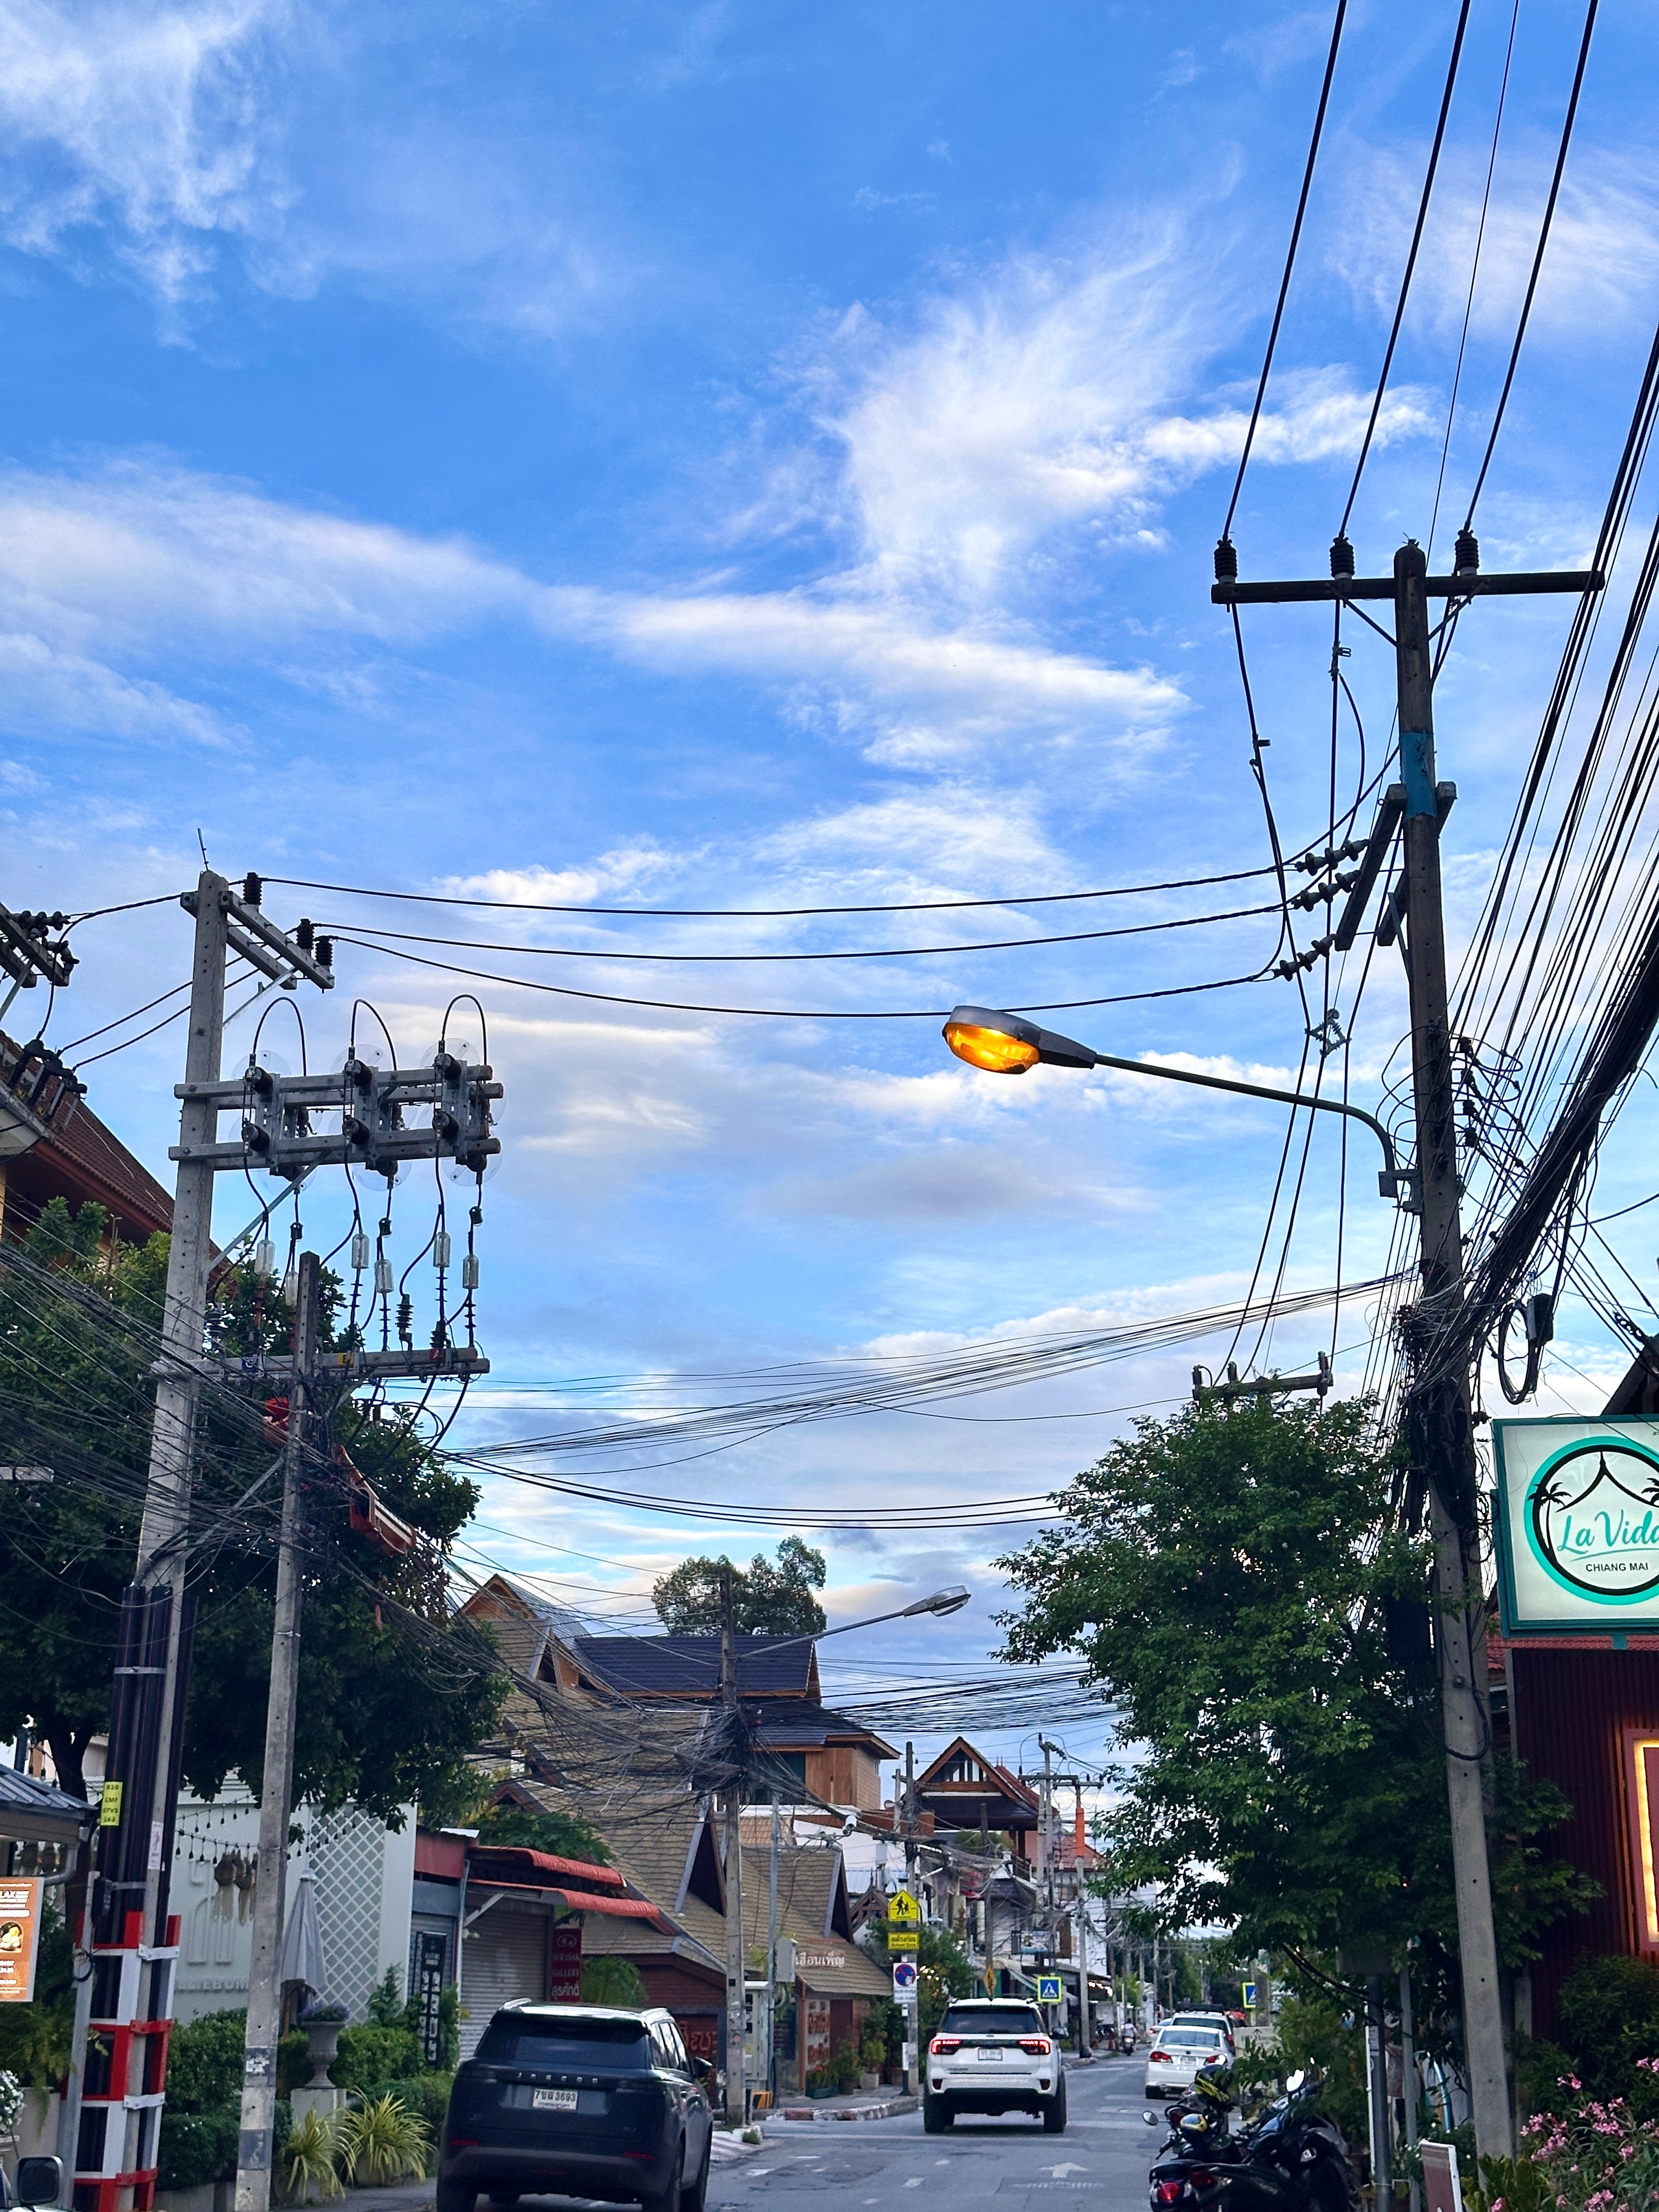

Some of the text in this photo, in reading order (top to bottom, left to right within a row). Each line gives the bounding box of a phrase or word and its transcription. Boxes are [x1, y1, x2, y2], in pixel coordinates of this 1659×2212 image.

[1556, 1515, 1595, 1555] La
[1585, 1562, 1649, 1572] CHIANG MAI
